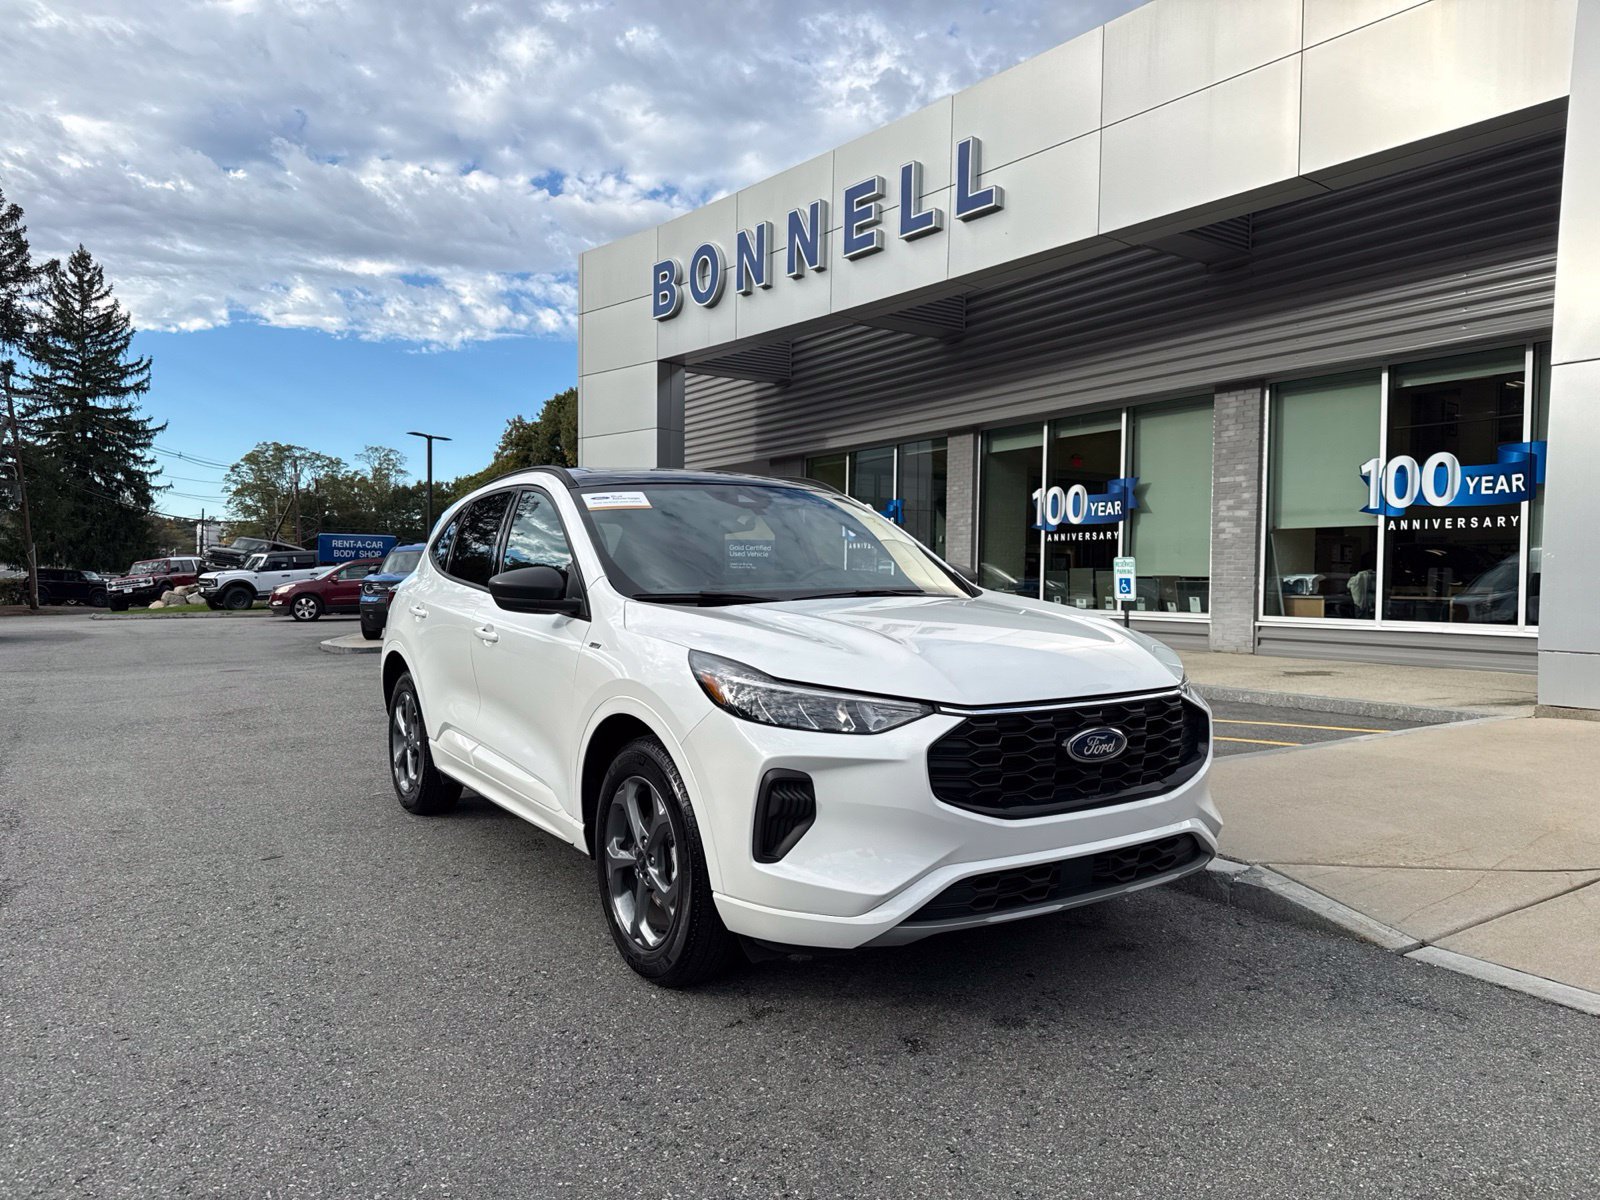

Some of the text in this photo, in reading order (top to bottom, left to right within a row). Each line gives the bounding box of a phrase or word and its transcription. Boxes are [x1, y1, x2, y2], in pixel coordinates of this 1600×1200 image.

[652, 136, 1003, 321] BONNELL
[1360, 452, 1526, 509] 100 YEAR
[1032, 484, 1122, 526] 100 YEAR
[1388, 515, 1520, 530] ANNIVERSARY
[1047, 531, 1119, 542] ANNIVERSARY
[331, 539, 383, 549] RENT-A-CAR
[745, 544, 772, 552] Certified
[333, 549, 382, 558] BODY SHOP
[746, 550, 769, 558] Vehicle
[1083, 735, 1116, 756] Ford
